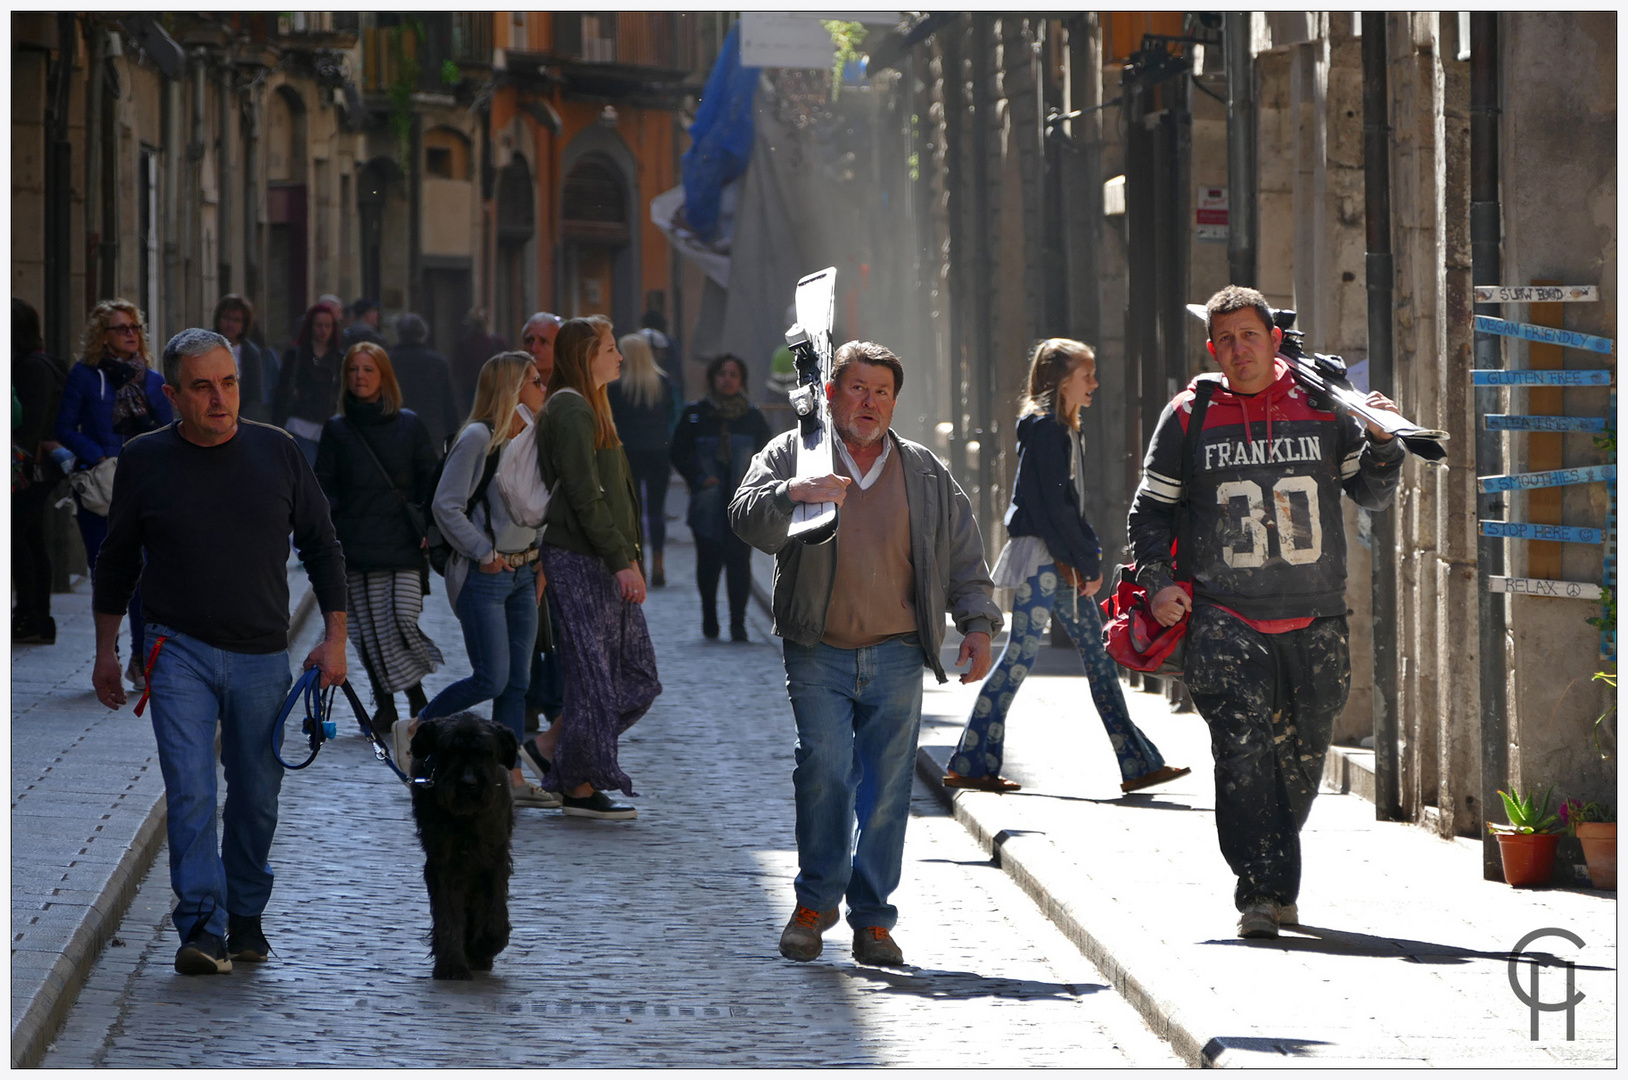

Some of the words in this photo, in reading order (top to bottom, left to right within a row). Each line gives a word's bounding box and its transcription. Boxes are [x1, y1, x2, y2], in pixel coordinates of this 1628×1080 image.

[1479, 319, 1520, 336] VEGAN
[1523, 324, 1589, 347] FRIENDLY
[1487, 371, 1545, 385] GLUTEN
[1547, 371, 1582, 385] FREE
[1501, 416, 1530, 430] TEA
[1205, 436, 1322, 470] FRANKLIN
[1498, 469, 1580, 490] SMOOTHIES
[1216, 475, 1323, 569] 30
[1488, 523, 1528, 537] STOP
[1534, 525, 1571, 540] HERE
[1505, 578, 1558, 595] RELAX
